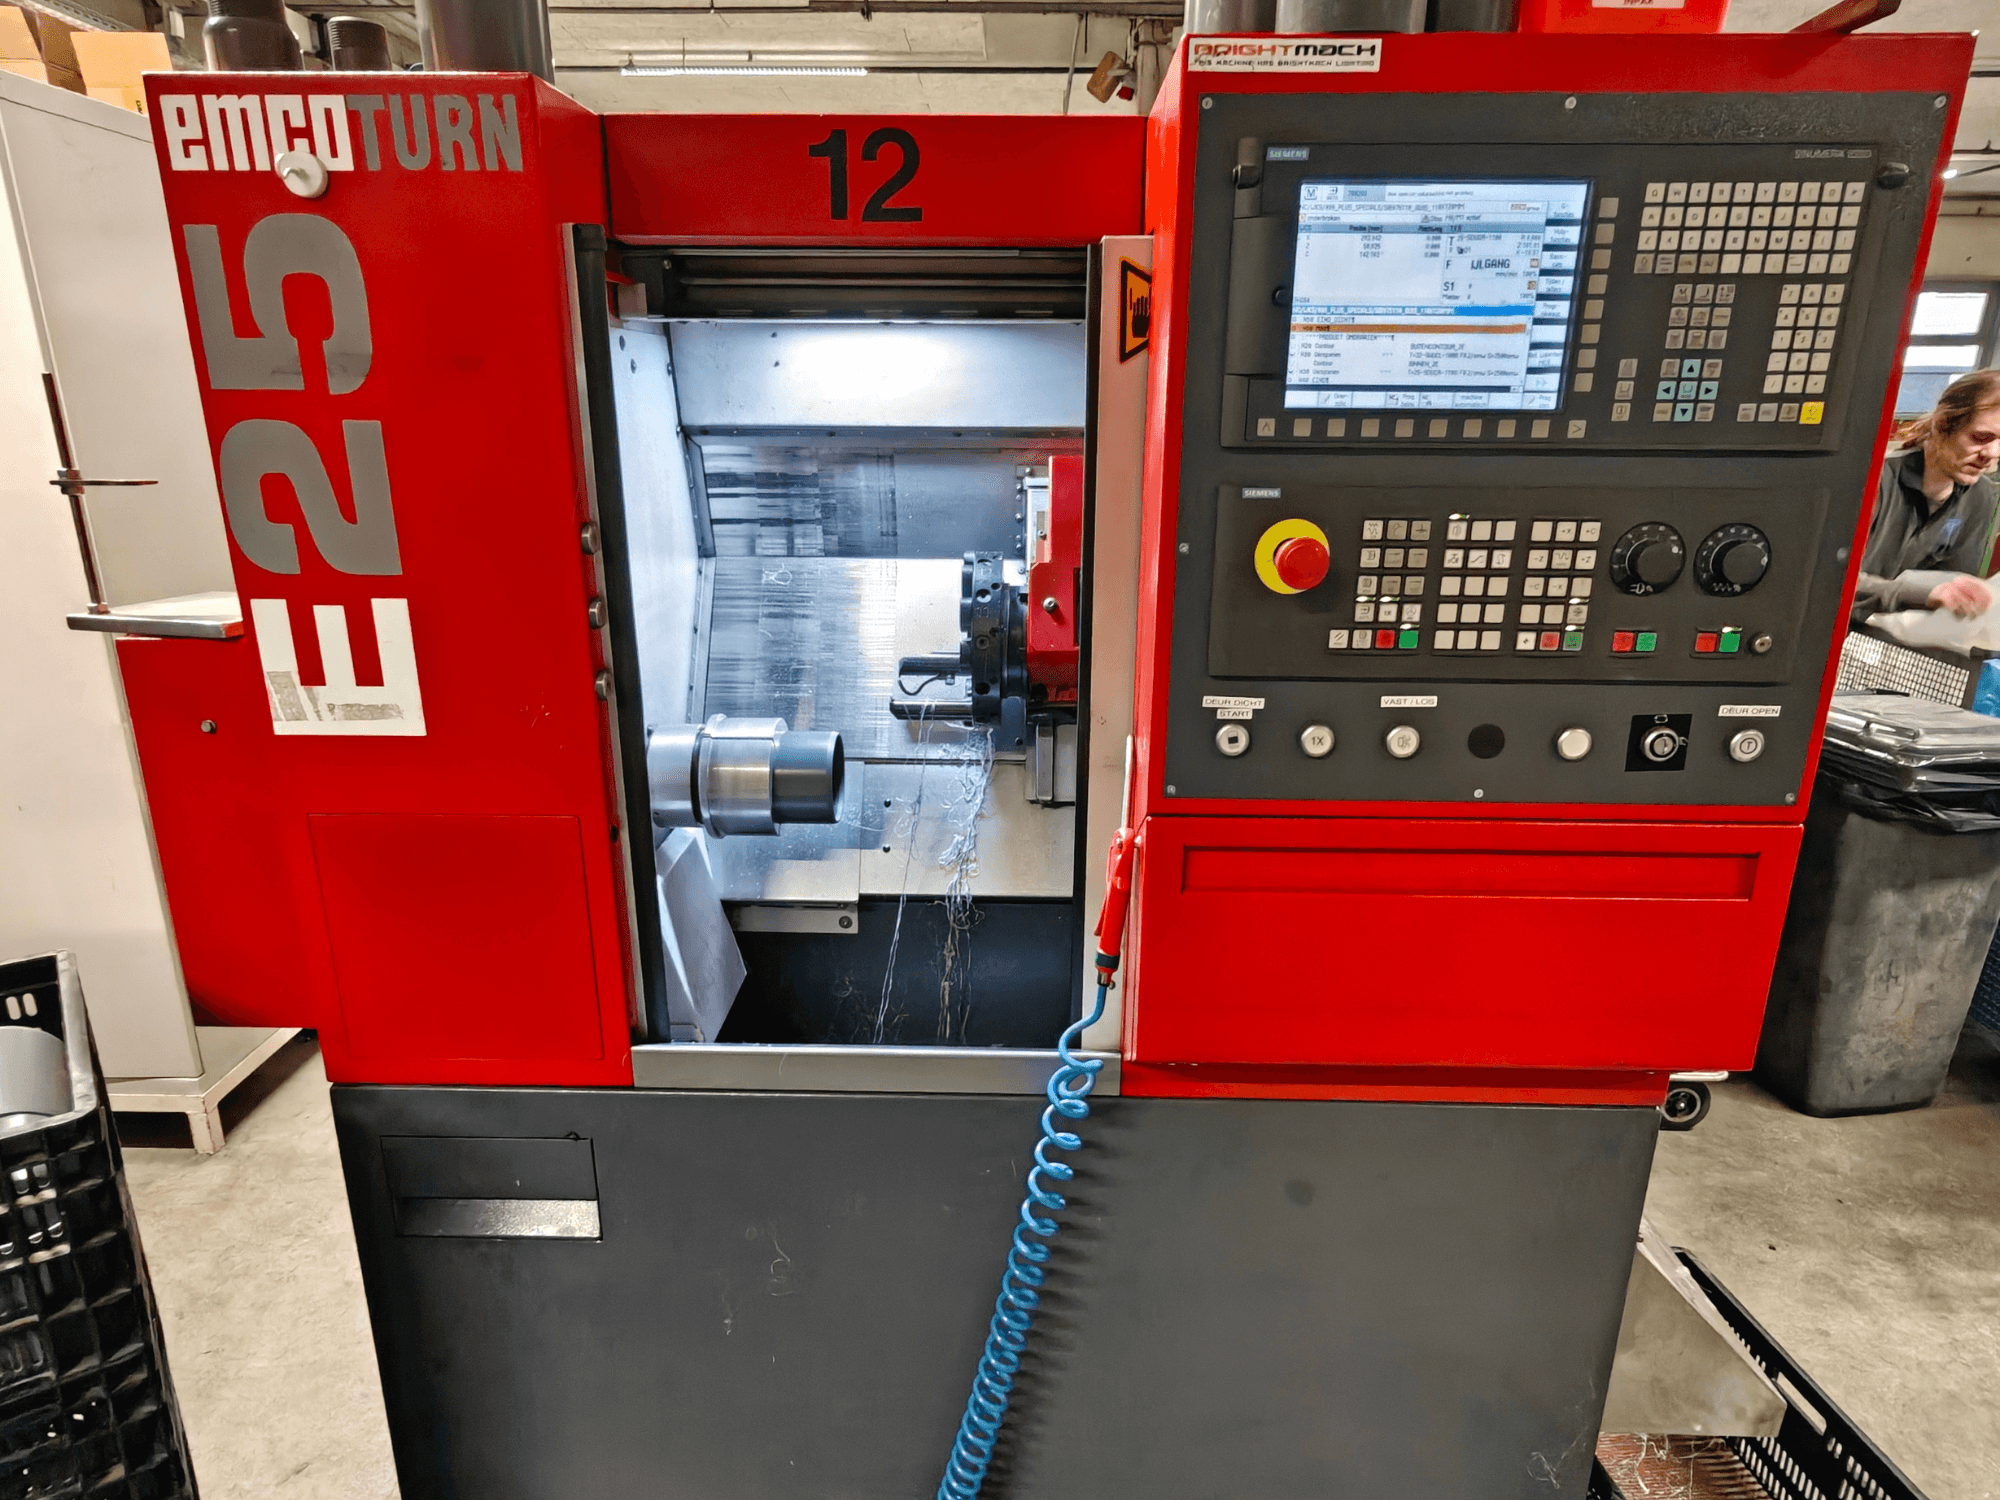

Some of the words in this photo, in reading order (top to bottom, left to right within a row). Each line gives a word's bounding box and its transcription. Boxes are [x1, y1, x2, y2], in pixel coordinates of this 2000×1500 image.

[808, 128, 922, 223] 12
[183, 212, 427, 736] E25
[1205, 698, 1231, 706] DEUR
[1234, 699, 1263, 707] DICHT
[1384, 698, 1408, 706] VAST
[1416, 698, 1435, 706] LOS
[1219, 710, 1250, 718] START
[1721, 706, 1749, 715] DEUR
[1751, 706, 1779, 715] OPEN
[1311, 735, 1325, 746] 1X
